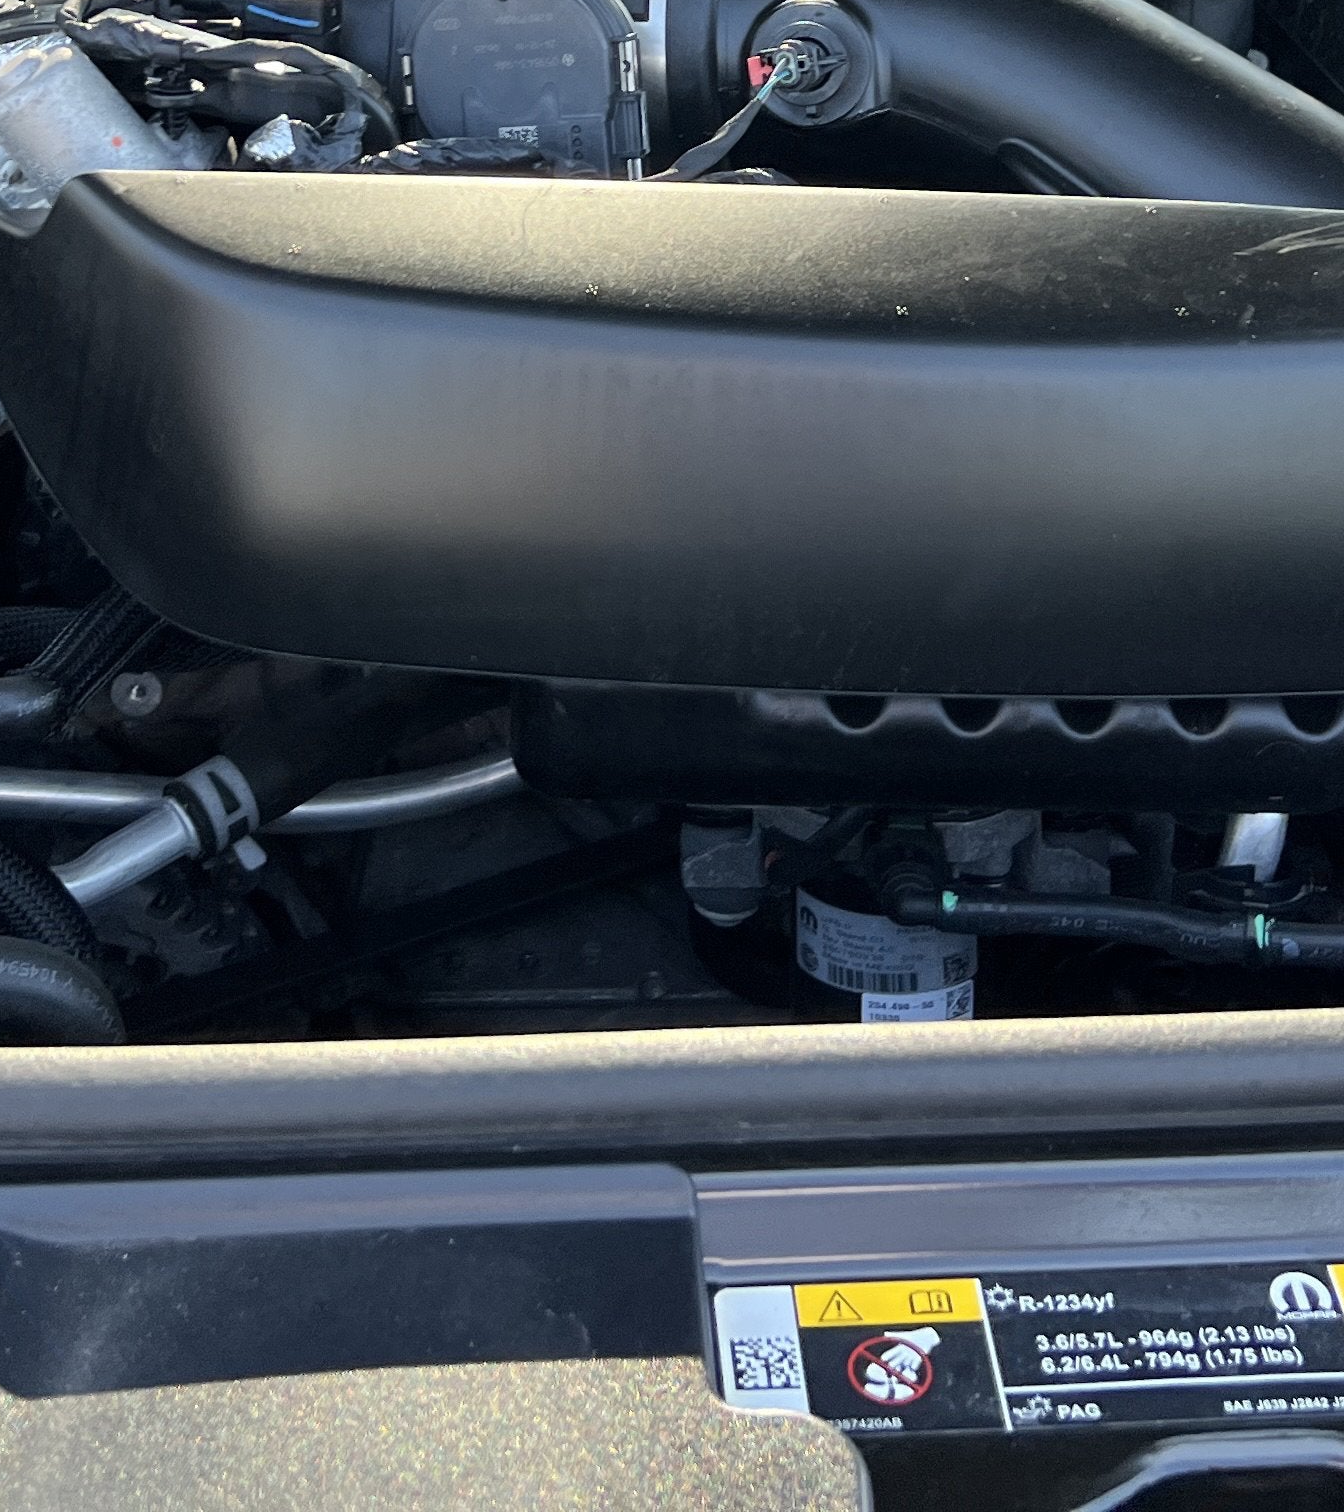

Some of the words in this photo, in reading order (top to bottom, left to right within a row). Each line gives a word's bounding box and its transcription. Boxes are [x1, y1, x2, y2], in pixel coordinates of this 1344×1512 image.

[1018, 1292, 1116, 1314] R-1234yf
[1035, 1332, 1124, 1353] 3.6/5.7L
[1199, 1325, 1251, 1346] (2.13
[1253, 1324, 1297, 1345] lbs)
[1040, 1353, 1131, 1375] 6.2/6.4L
[1205, 1347, 1258, 1369] (1.75
[1260, 1346, 1304, 1366] lbs)
[1056, 1403, 1102, 1421] PAG
